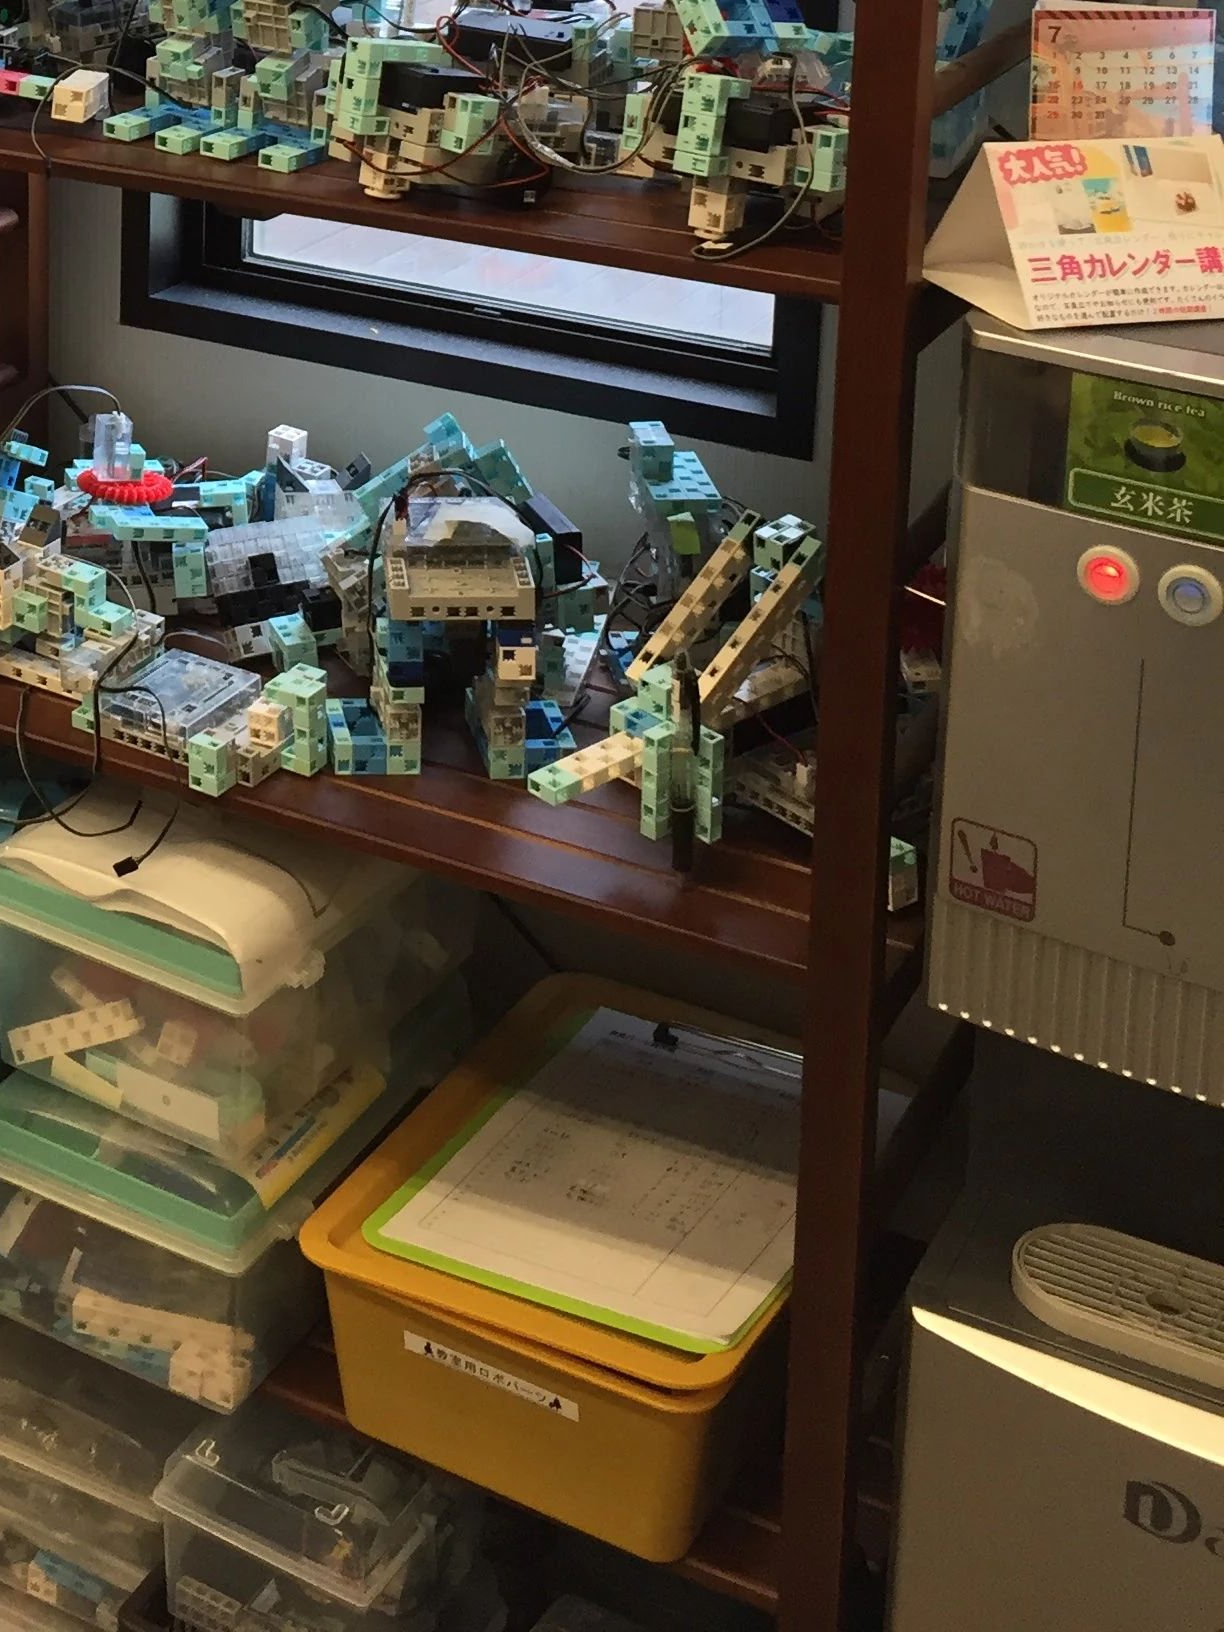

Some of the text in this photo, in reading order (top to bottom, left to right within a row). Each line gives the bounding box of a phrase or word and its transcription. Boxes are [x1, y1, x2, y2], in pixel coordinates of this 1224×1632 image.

[1028, 246, 1224, 284] 三角カレンダー講
[1113, 390, 1206, 418] Brown rice tea
[1110, 485, 1195, 524] 玄米茶
[953, 882, 1031, 919] HOT WATER
